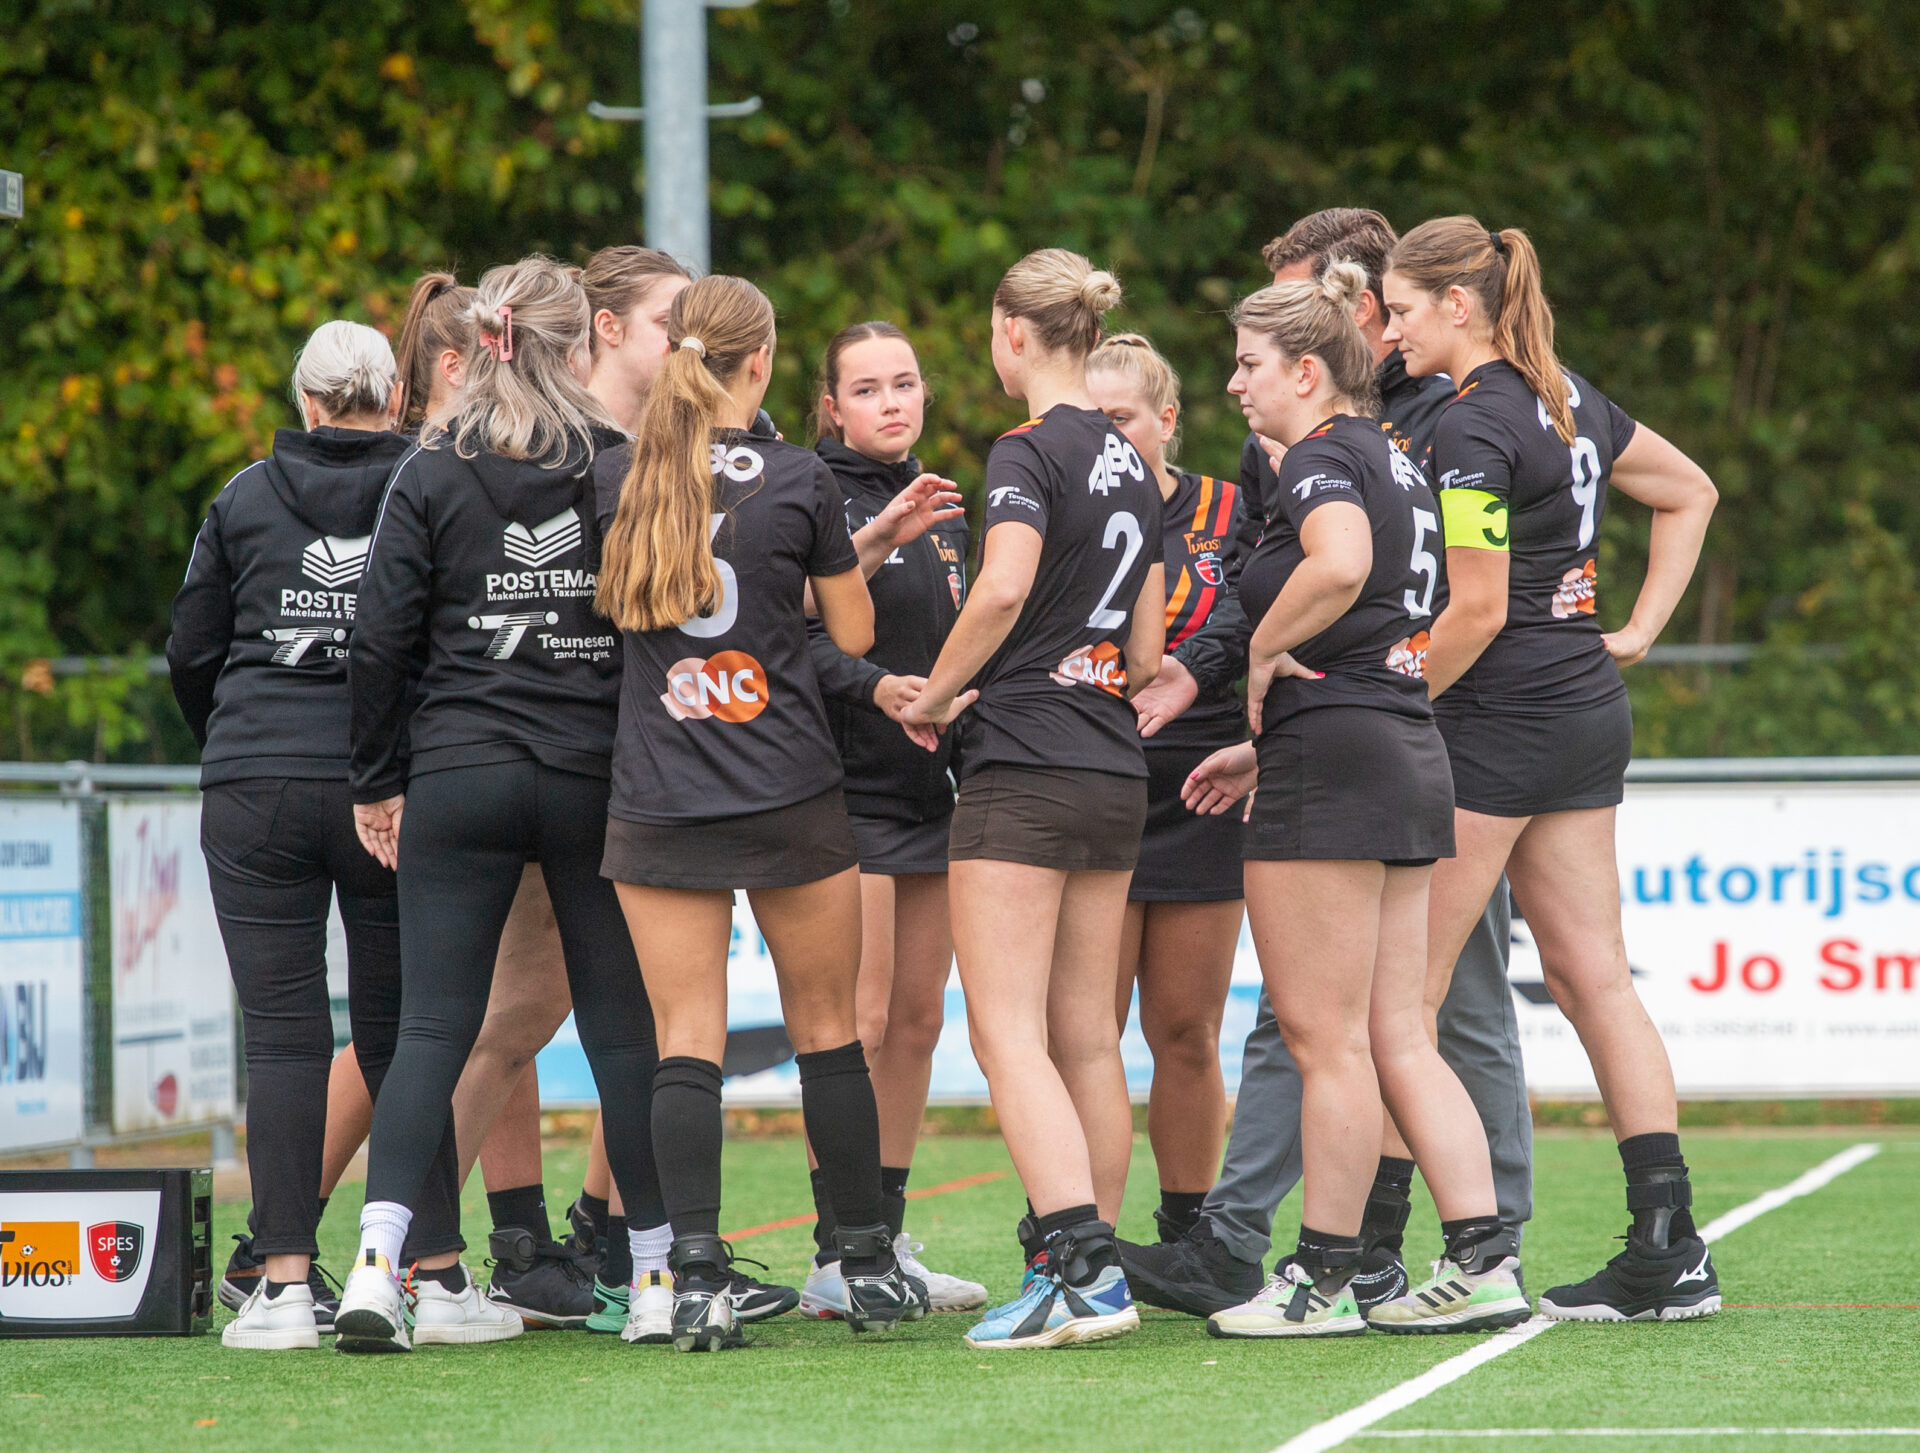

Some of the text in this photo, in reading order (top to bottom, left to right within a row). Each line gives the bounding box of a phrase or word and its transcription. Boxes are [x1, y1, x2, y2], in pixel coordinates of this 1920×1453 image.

[1570, 437, 1602, 551] 9
[1086, 511, 1144, 630] 2
[1404, 506, 1438, 619] 5
[486, 570, 597, 592] POSTEMA
[281, 588, 358, 612] POSTE
[487, 588, 597, 602] Makelaars & Taxateurs
[280, 608, 332, 618] Makelaars
[335, 610, 342, 618] &
[537, 633, 615, 649] Teunesen
[554, 651, 577, 660] zand
[671, 669, 759, 706] CNC
[1620, 849, 1920, 918] utorijsc
[1688, 938, 1920, 993] Jo Sm
[97, 1236, 134, 1251] SPES
